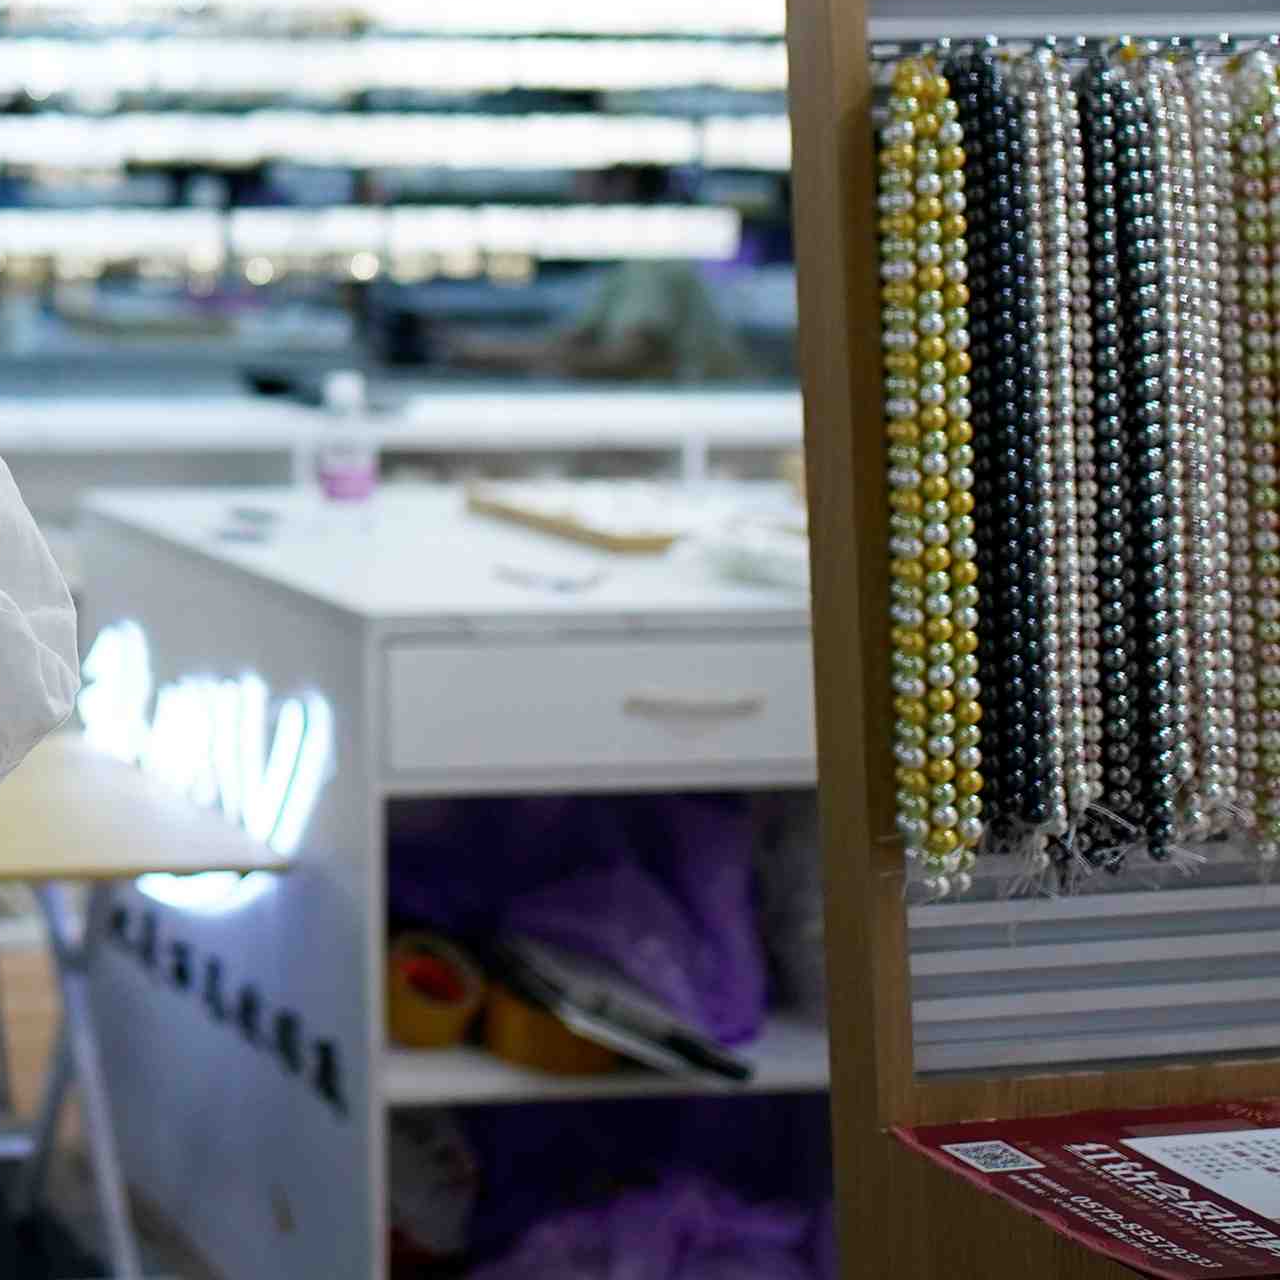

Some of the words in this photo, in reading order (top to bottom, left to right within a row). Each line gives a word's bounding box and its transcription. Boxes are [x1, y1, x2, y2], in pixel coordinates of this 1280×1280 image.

[1062, 1141, 1280, 1258] 红钻会员招
